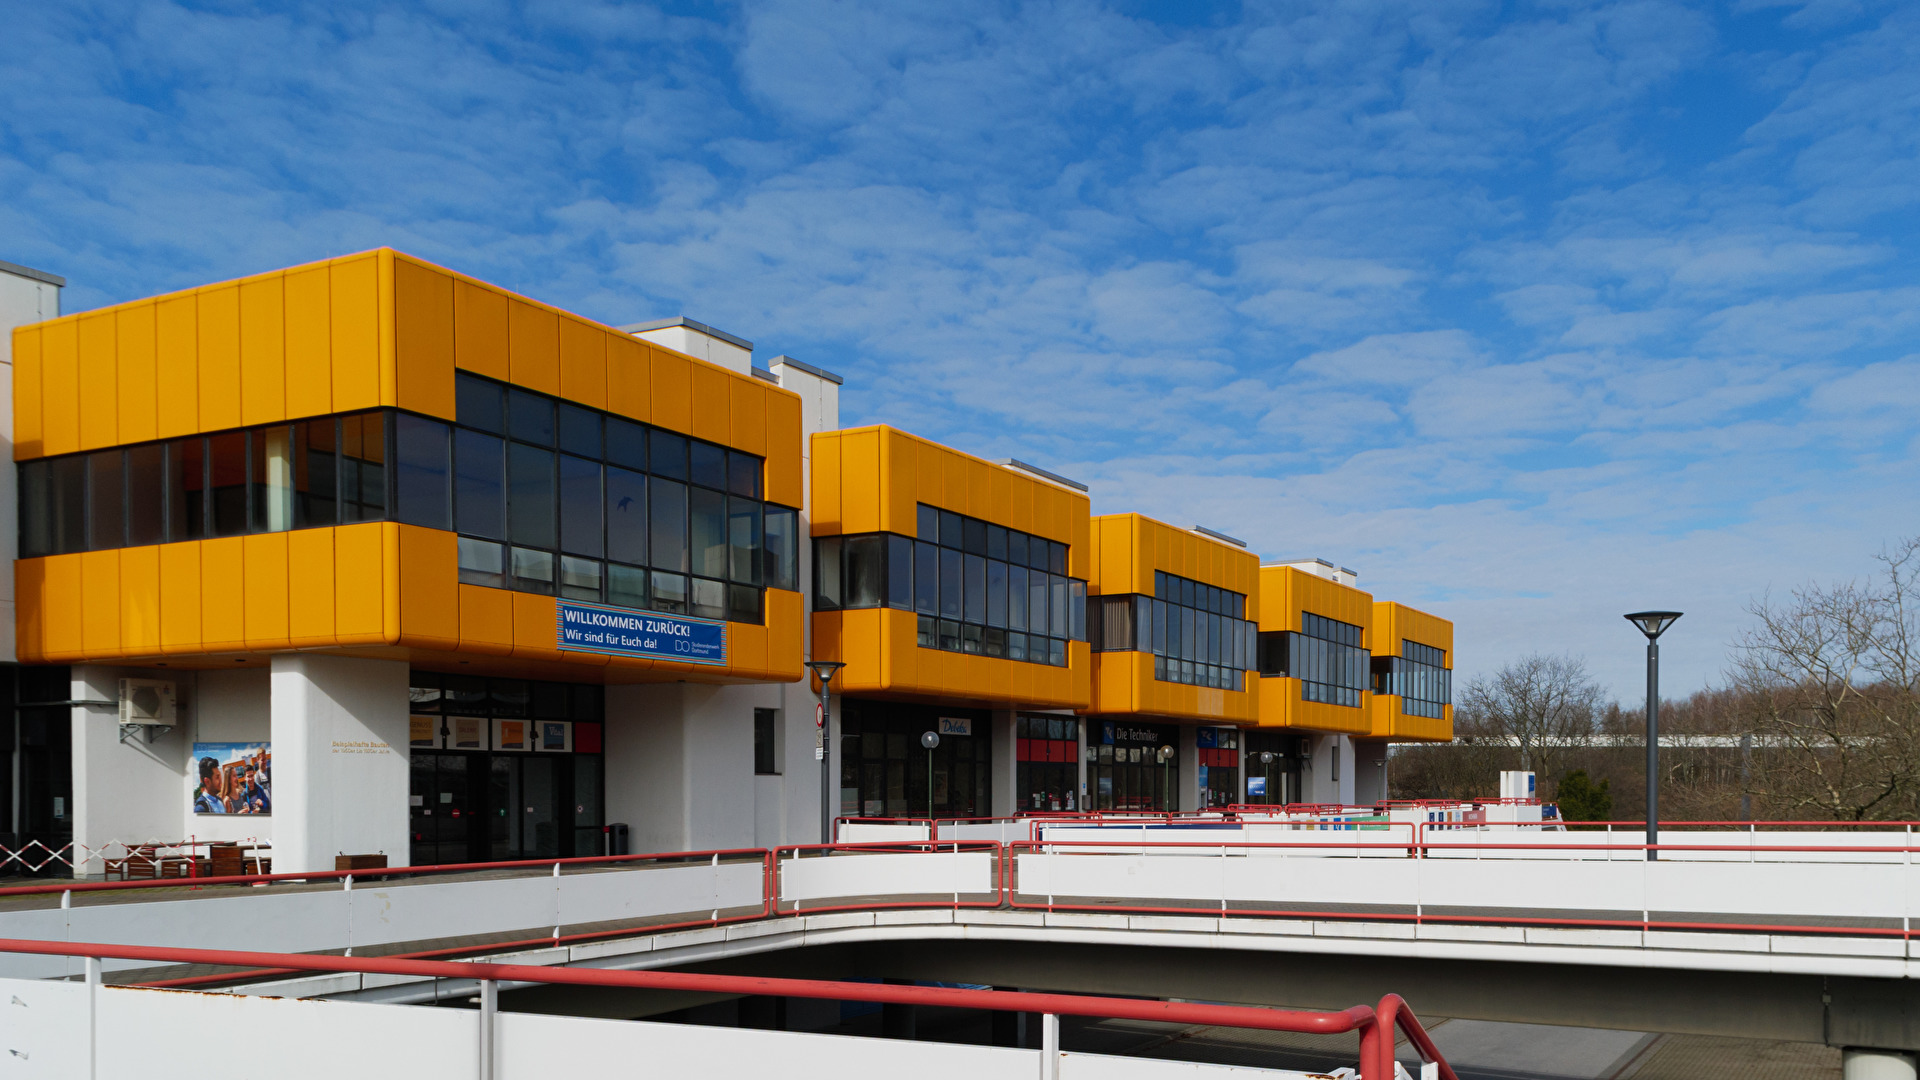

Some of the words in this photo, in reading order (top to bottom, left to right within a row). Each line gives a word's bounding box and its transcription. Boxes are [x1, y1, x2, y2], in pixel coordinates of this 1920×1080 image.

[565, 610, 643, 631] WILLKOMMEN
[646, 620, 690, 637] ZURÜCK!
[565, 628, 582, 641] Wir
[584, 631, 603, 644] sind
[606, 633, 619, 645] für
[621, 635, 642, 647] Euch
[644, 638, 658, 649] da!
[675, 639, 690, 653] DO
[410, 720, 432, 729] ENUSS
[548, 726, 564, 737] Vital
[942, 719, 968, 734] Debeka
[1116, 727, 1128, 740] Die
[1129, 728, 1158, 742] Techniker
